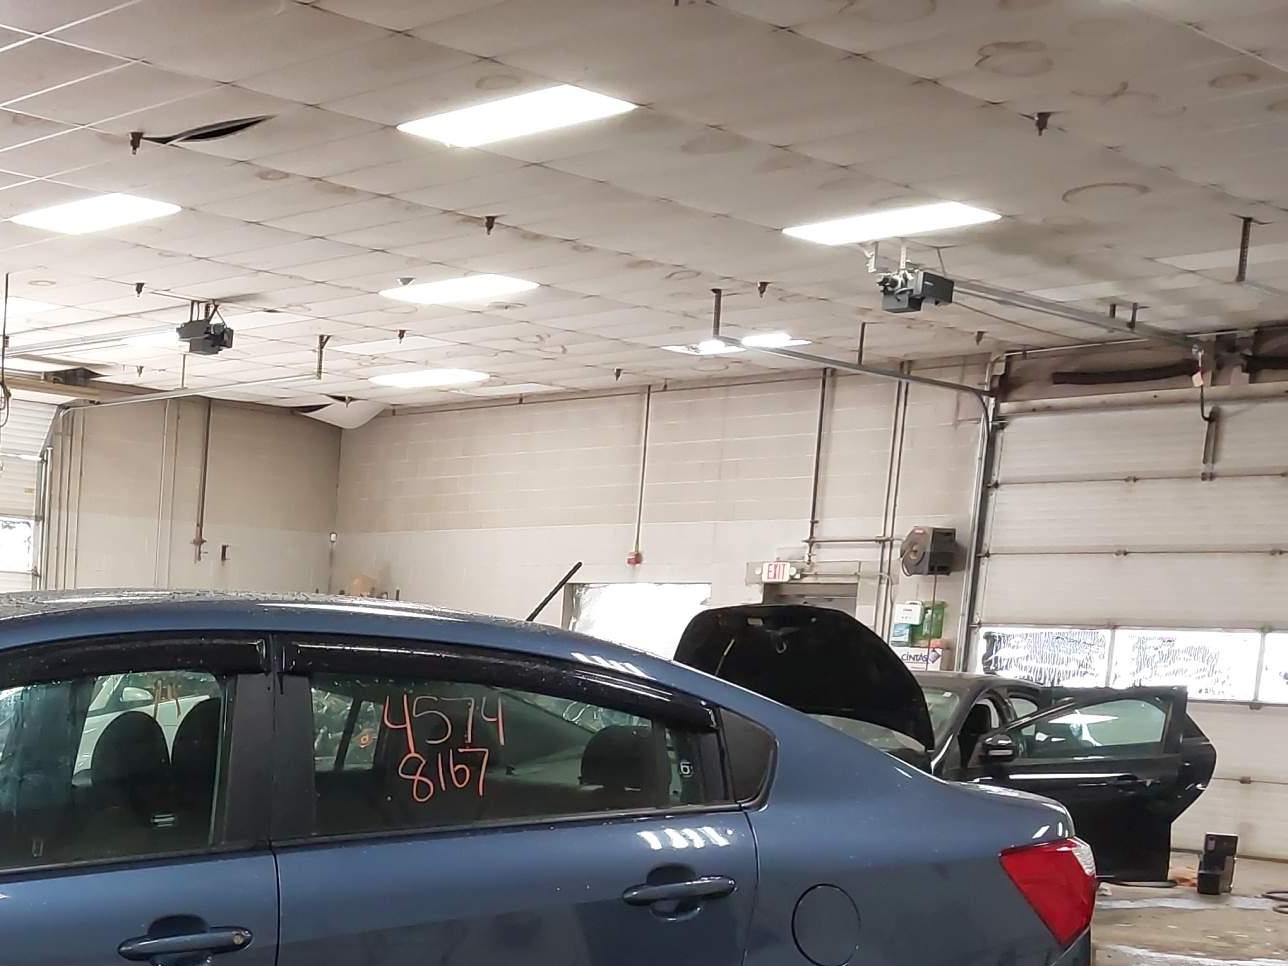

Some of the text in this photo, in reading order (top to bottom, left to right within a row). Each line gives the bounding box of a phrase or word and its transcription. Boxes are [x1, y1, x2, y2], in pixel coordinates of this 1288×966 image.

[768, 563, 785, 579] EXIT
[383, 693, 505, 755] 4574
[399, 747, 489, 802] 8167
